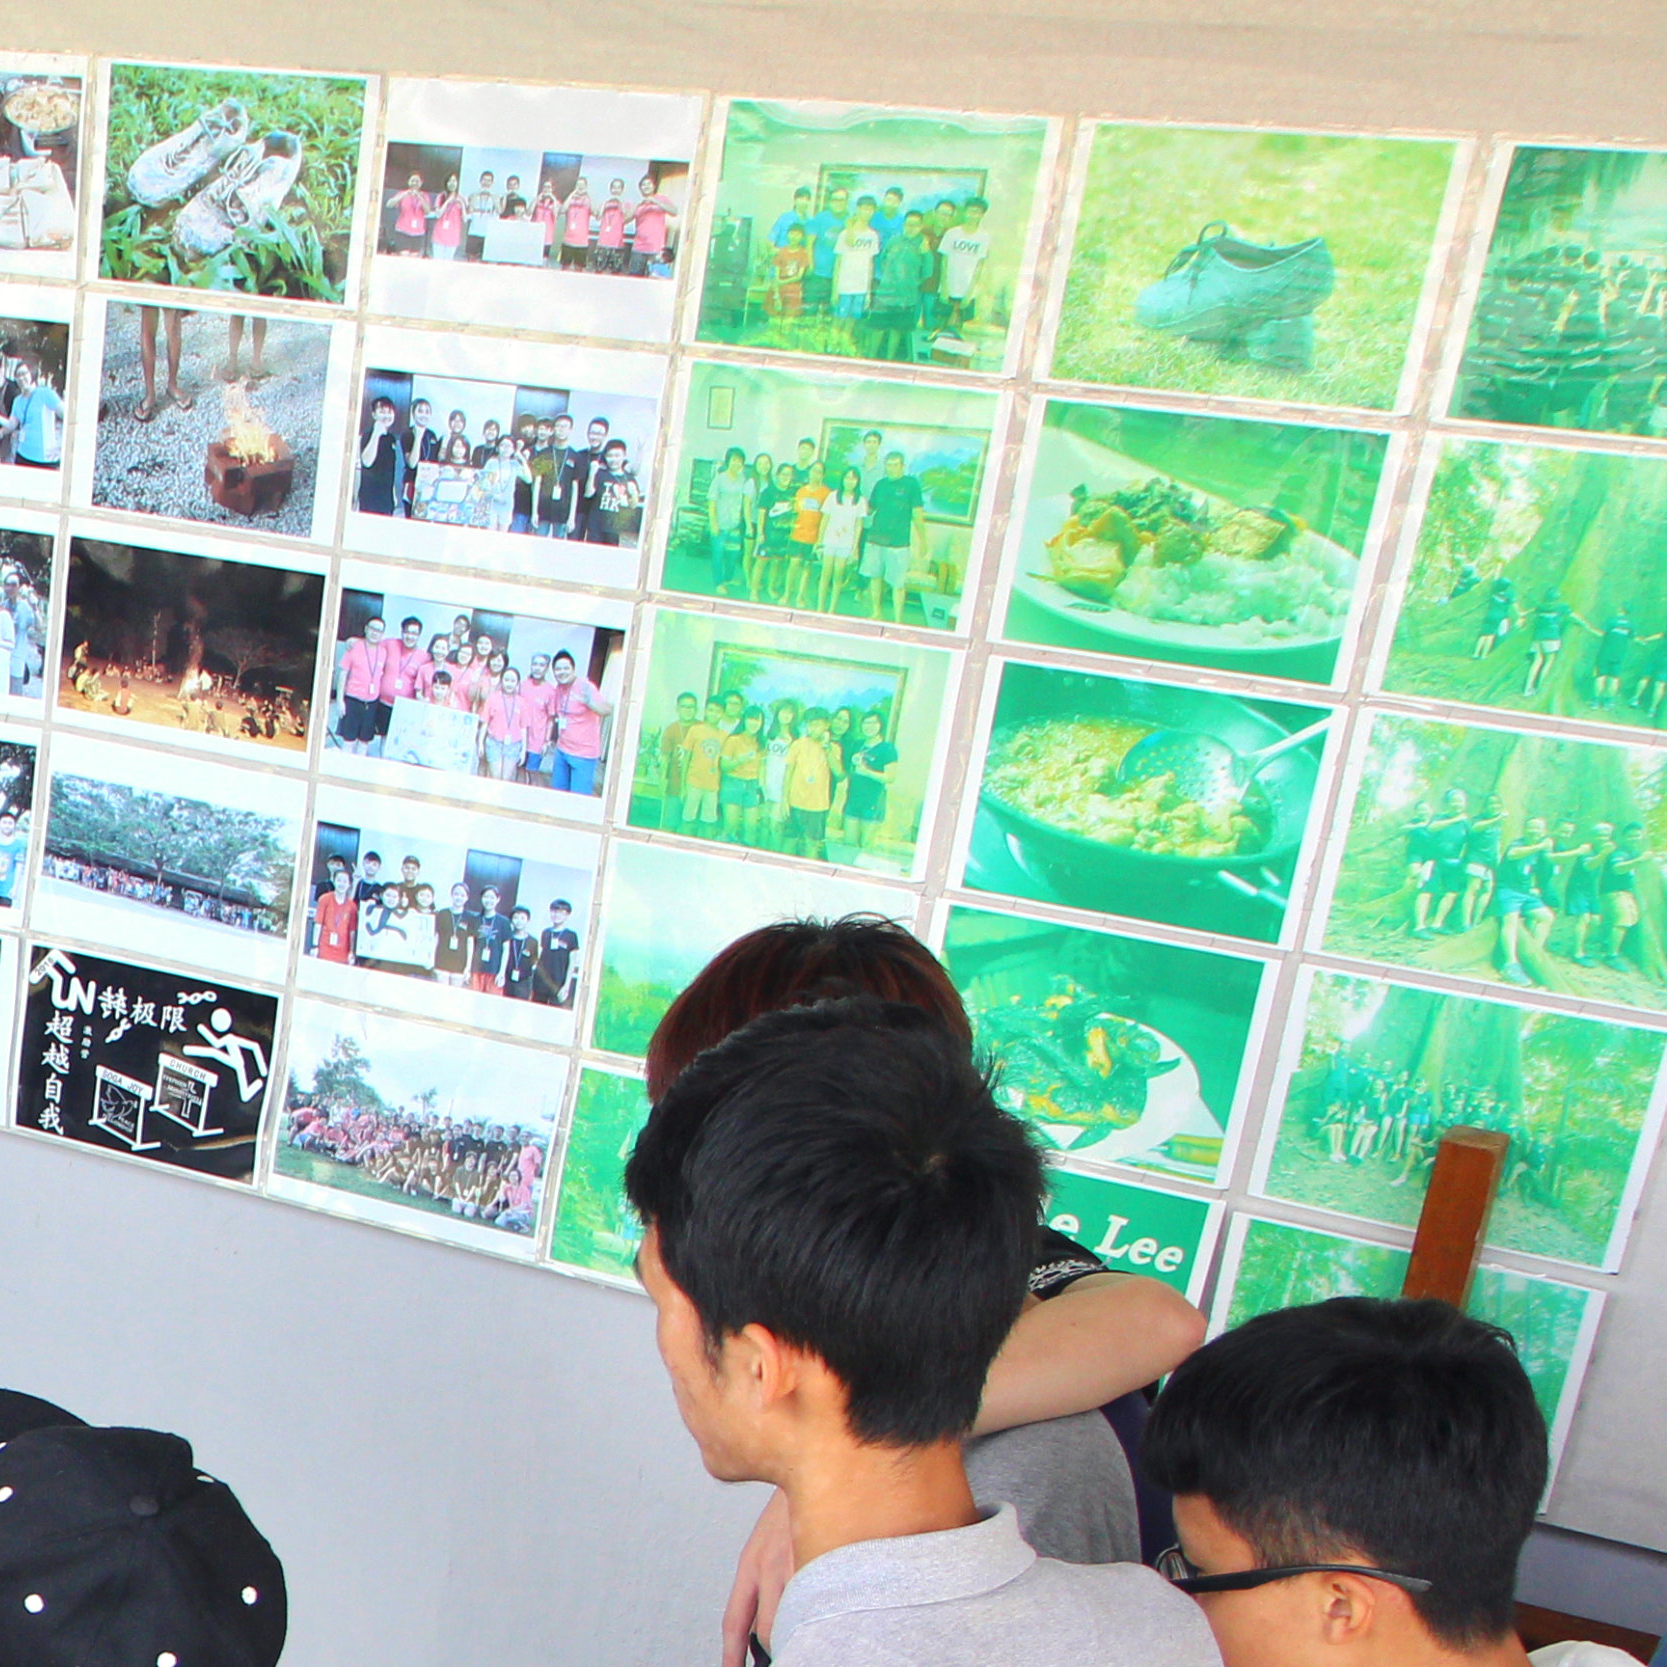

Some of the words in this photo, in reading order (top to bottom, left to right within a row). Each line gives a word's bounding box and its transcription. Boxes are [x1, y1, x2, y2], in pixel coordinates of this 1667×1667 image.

[37, 1010, 75, 1136] 超越自我
[169, 1059, 207, 1081] CHURCH
[1093, 1213, 1185, 1273] Lee
